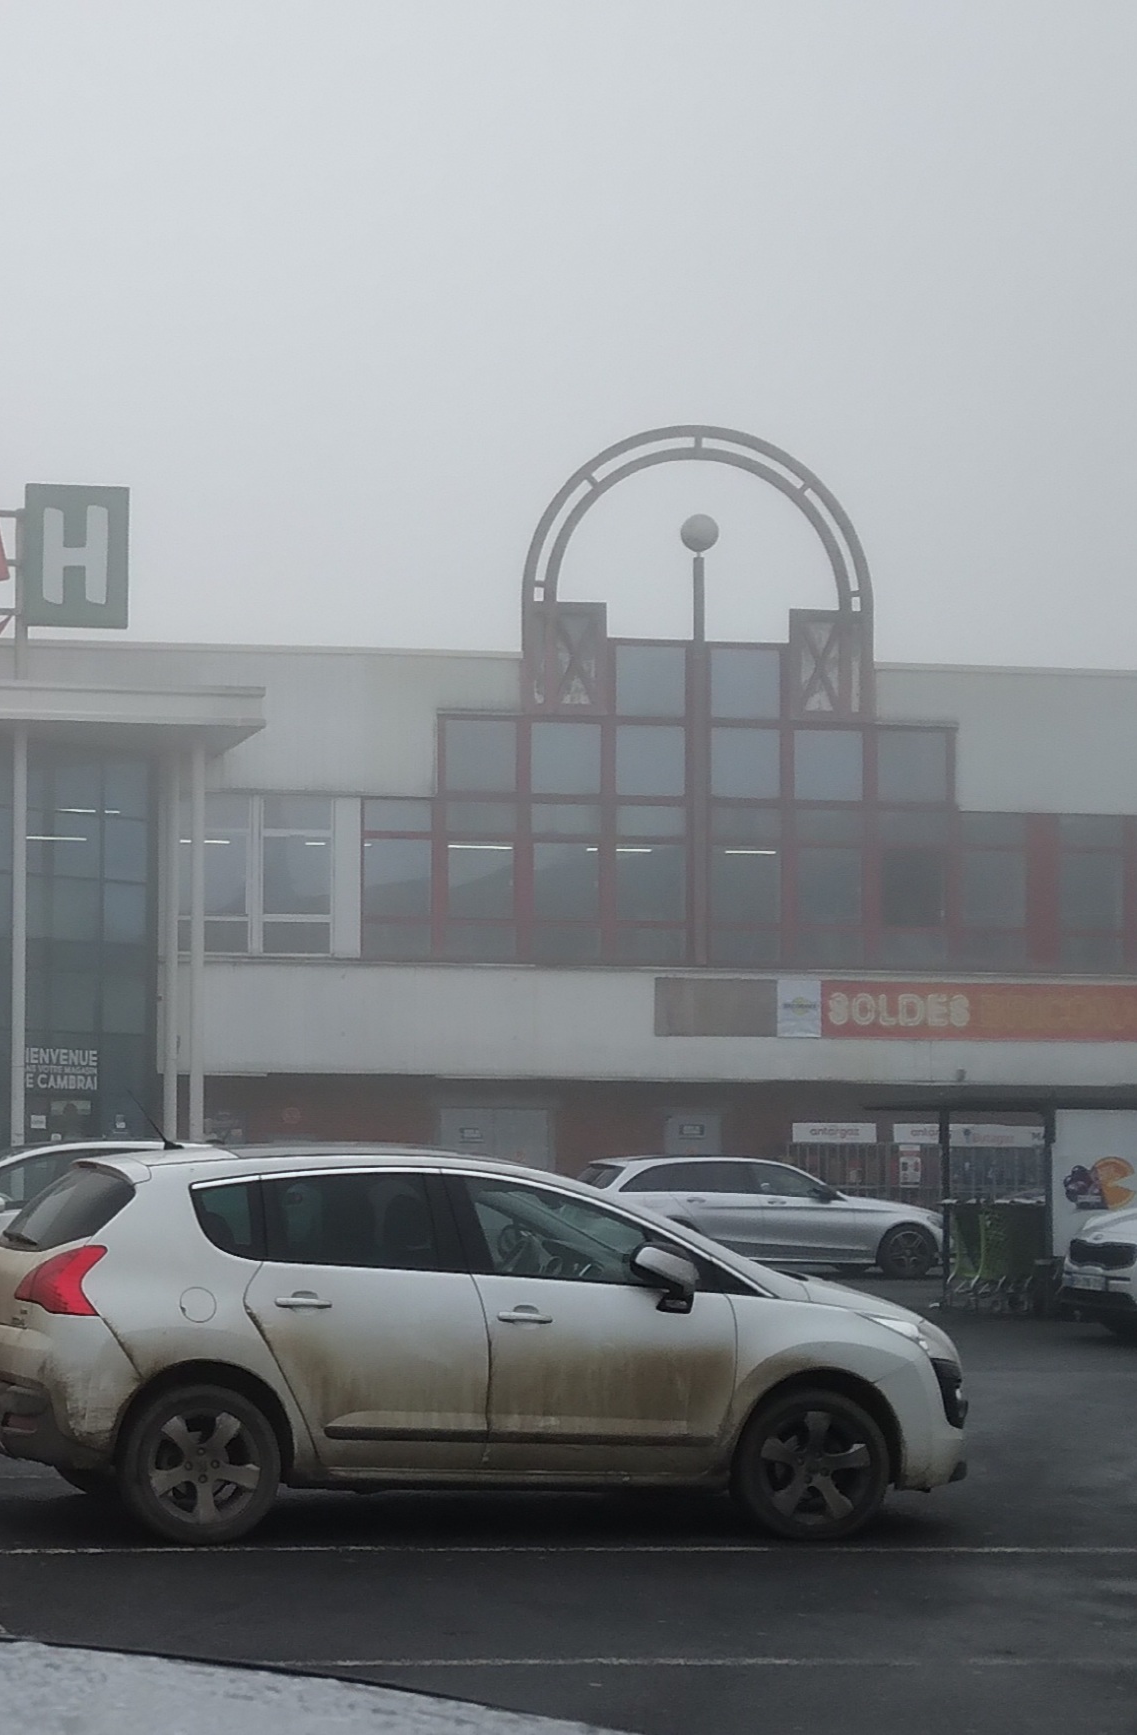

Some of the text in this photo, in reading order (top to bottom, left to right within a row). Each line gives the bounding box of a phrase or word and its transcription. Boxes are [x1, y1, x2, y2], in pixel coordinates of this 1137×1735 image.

[828, 992, 971, 1027] SOLDES
[25, 1047, 98, 1066] IENVENUE
[25, 1073, 98, 1090] E CAMBRAI
[809, 1127, 860, 1139] antargaz
